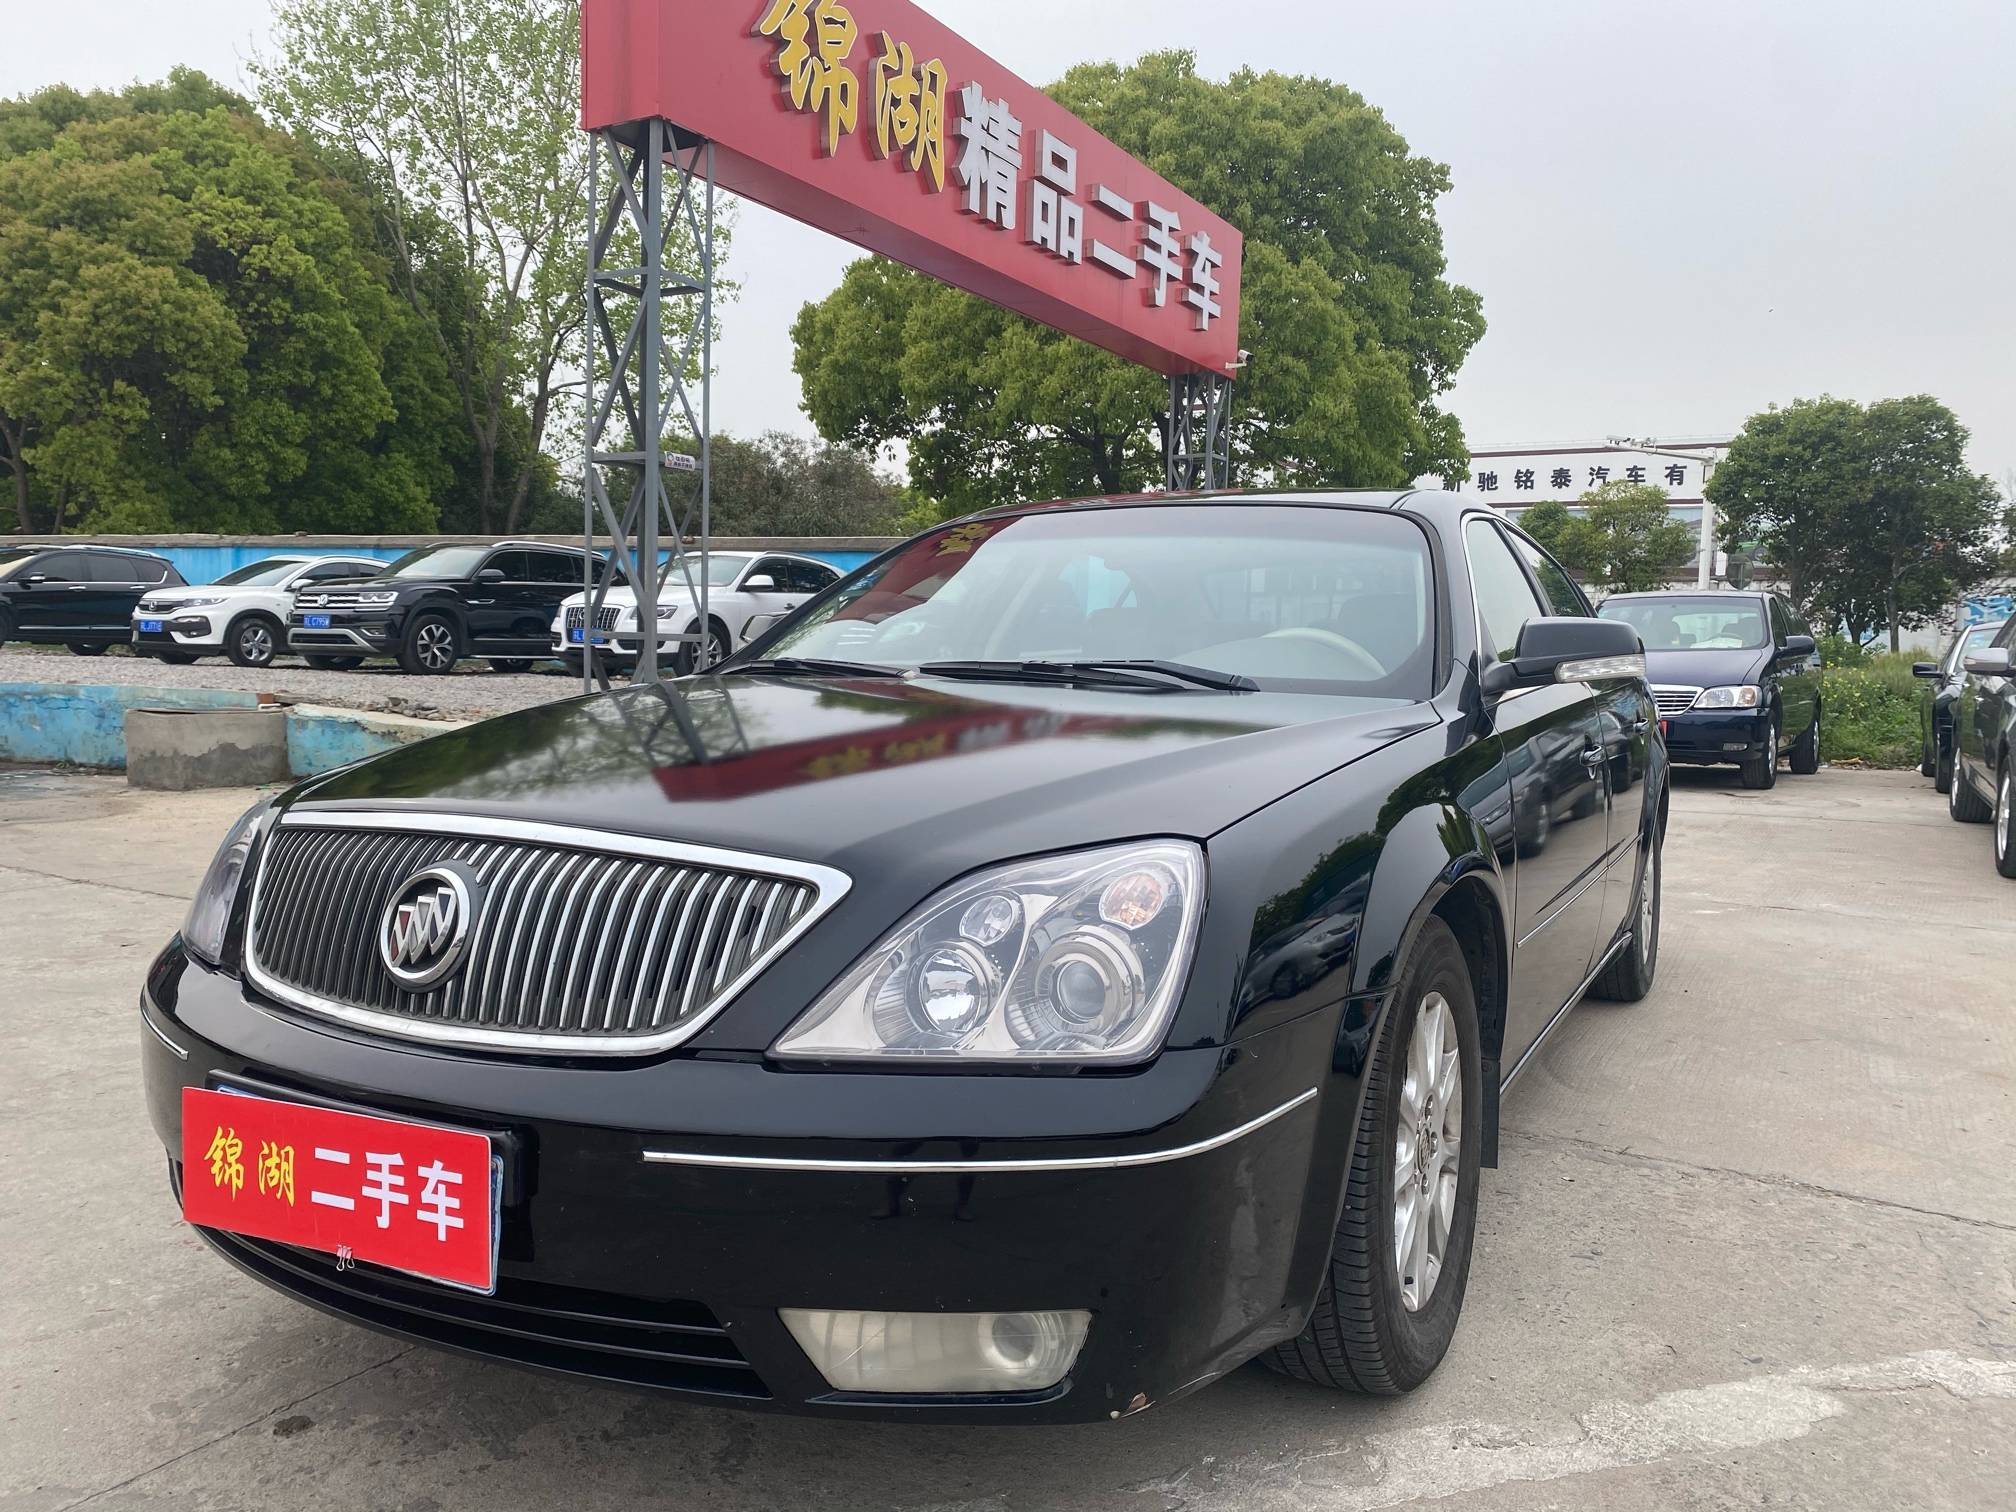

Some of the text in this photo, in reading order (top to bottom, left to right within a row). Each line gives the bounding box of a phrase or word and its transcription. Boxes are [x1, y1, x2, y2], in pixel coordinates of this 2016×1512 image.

[754, 0, 1222, 331] 锦湖精品二手车
[203, 1125, 465, 1242] 锦湖二手车
